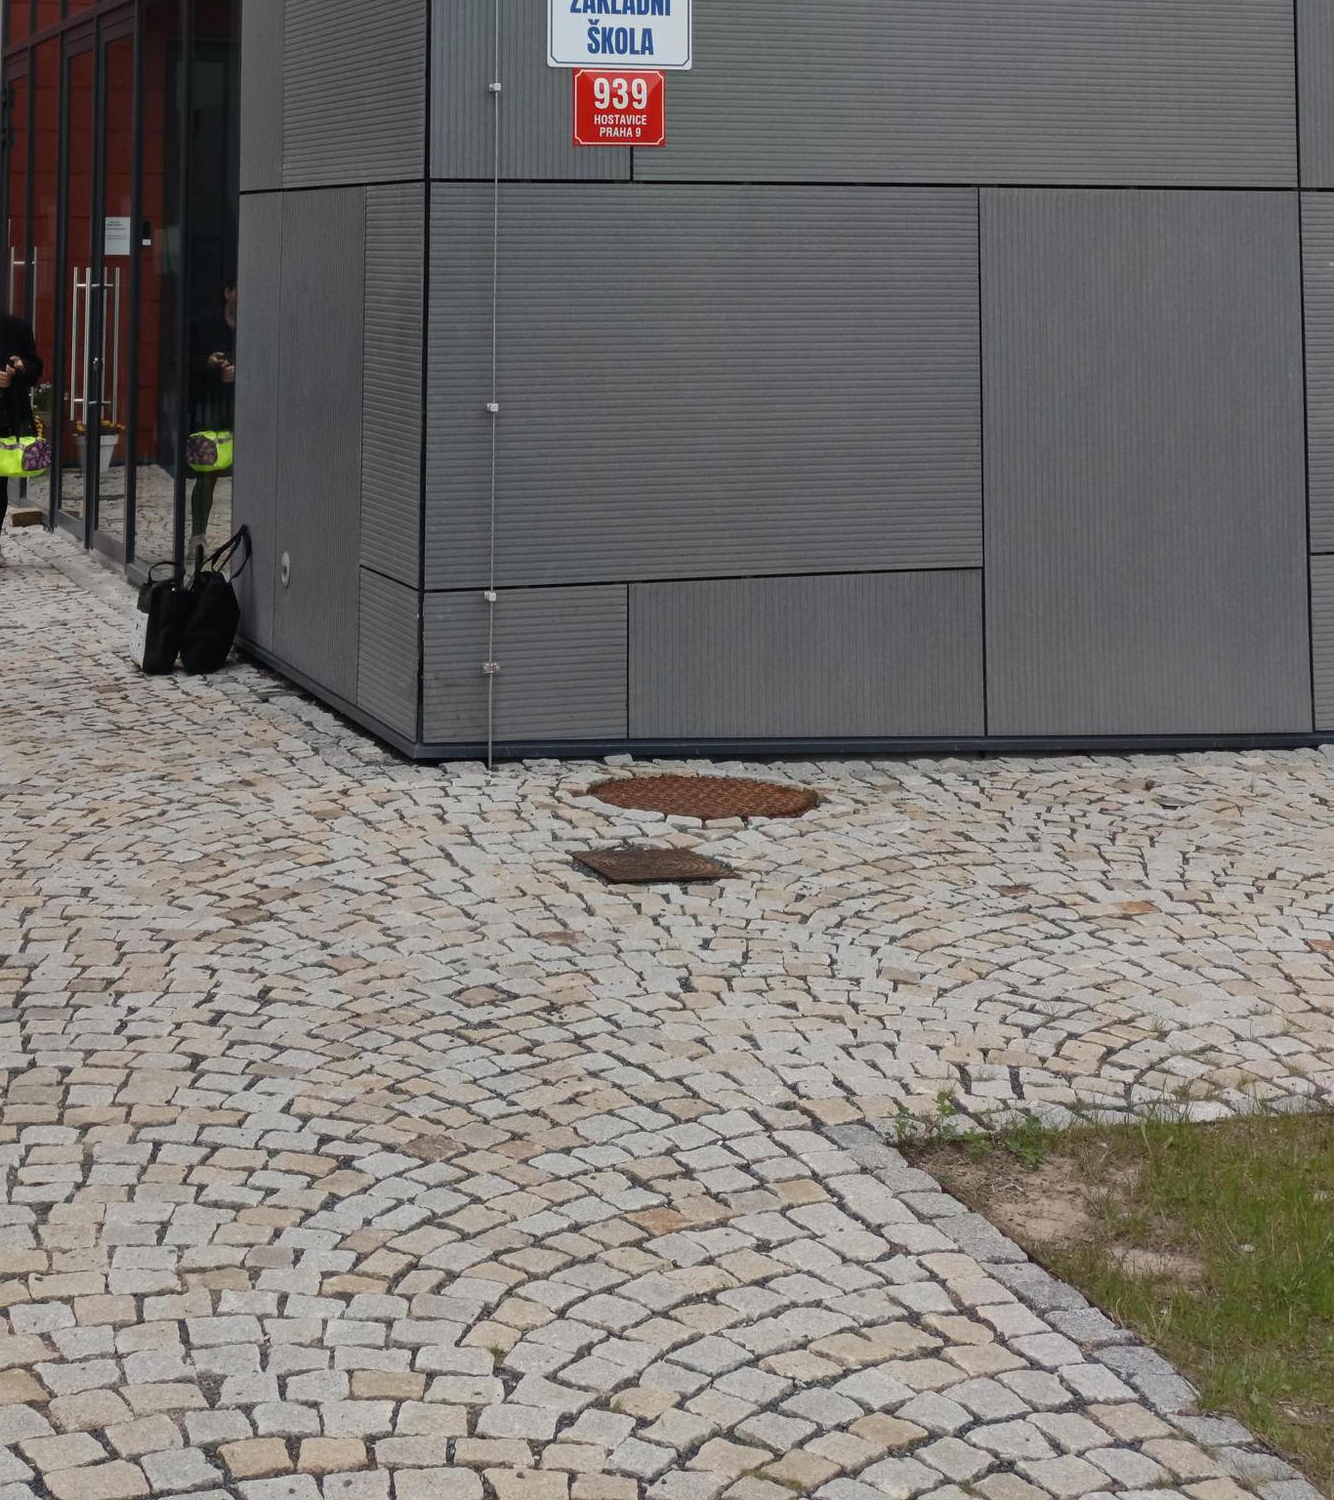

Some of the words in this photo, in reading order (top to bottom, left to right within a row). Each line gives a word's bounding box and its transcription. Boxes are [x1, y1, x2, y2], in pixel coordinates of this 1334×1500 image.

[587, 18, 654, 56] ŠKOLA
[593, 77, 648, 110] 939
[594, 114, 647, 126] HOSTAVICE
[599, 126, 633, 138] PRAHA
[635, 127, 642, 138] 9
